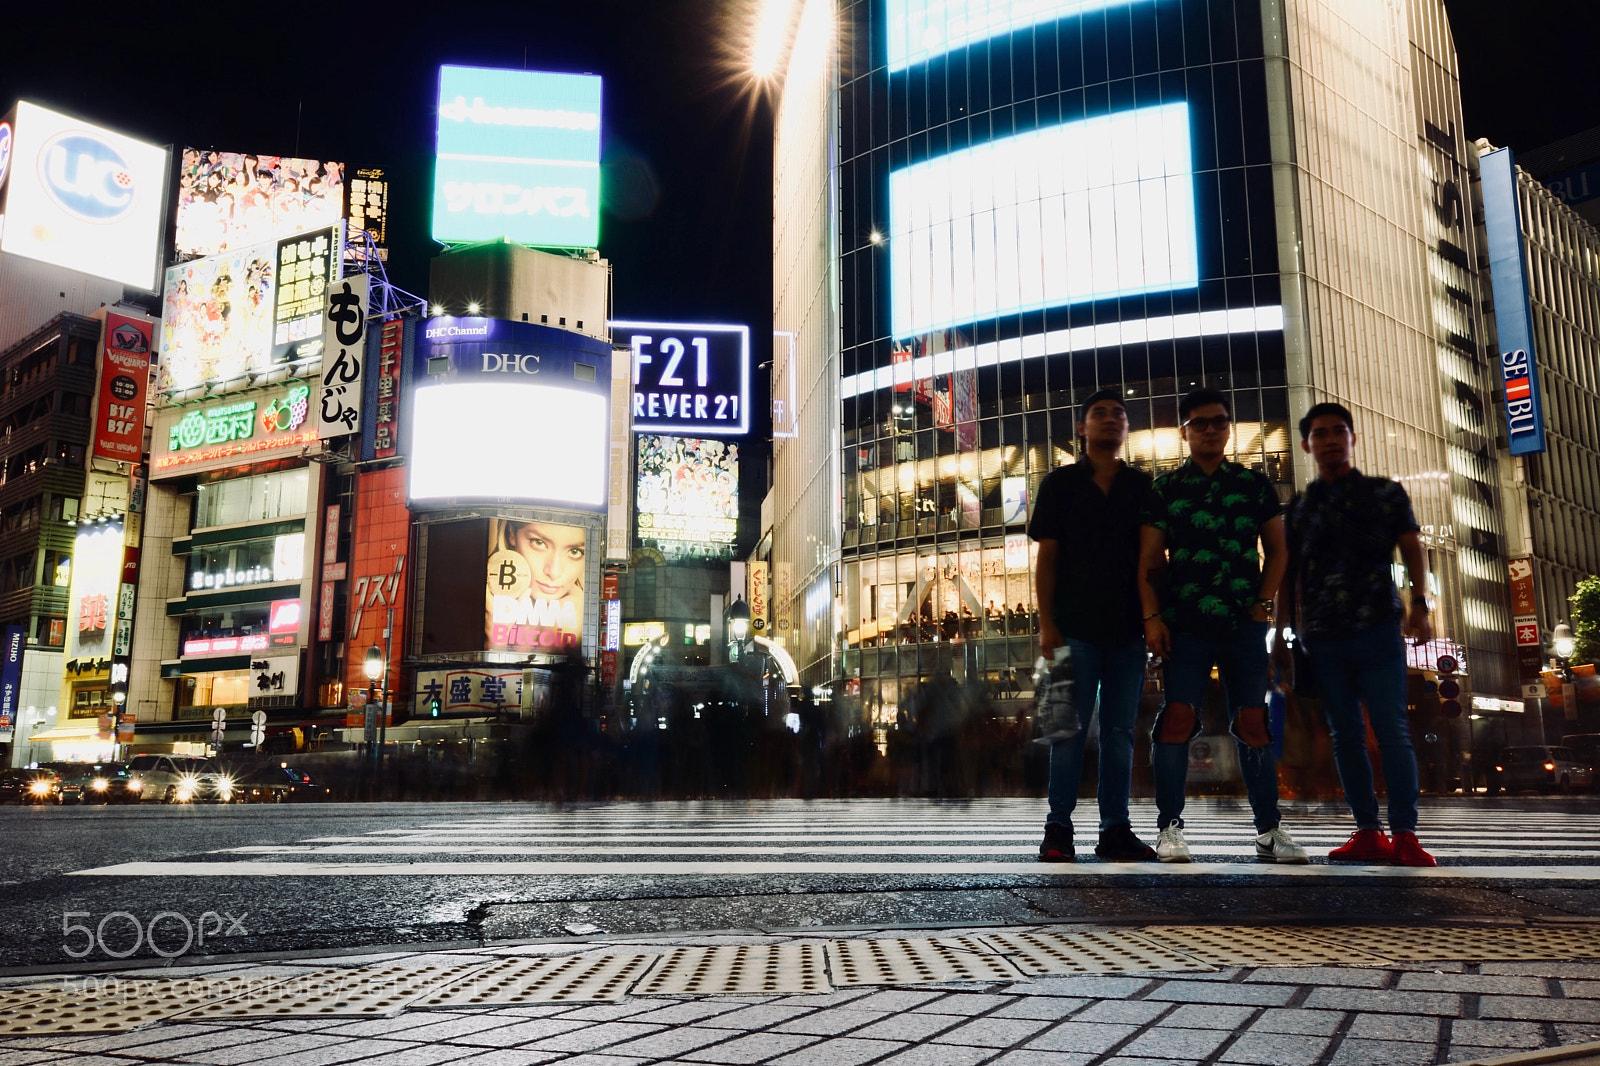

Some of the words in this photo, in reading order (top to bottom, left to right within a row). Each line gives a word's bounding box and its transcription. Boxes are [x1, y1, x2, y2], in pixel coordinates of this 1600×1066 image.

[425, 328, 447, 339] DHC
[448, 325, 488, 337] Channel
[320, 281, 364, 431] もんじゃ
[481, 353, 540, 375] DHC
[374, 325, 397, 450] 三千里薬品
[1502, 348, 1535, 435] SEIBU
[109, 403, 135, 420] B1F
[714, 394, 739, 419] 21
[107, 418, 135, 435] B2F
[206, 413, 255, 444] 西村
[192, 565, 271, 589] Euphoria
[78, 593, 109, 632] 薬
[350, 555, 405, 640] クスリ
[493, 590, 578, 629] DMM
[10, 632, 21, 662] MIZUHO
[491, 624, 577, 648] Bitcoin
[1519, 627, 1535, 642] 本
[2, 683, 13, 716] みずほ銀行
